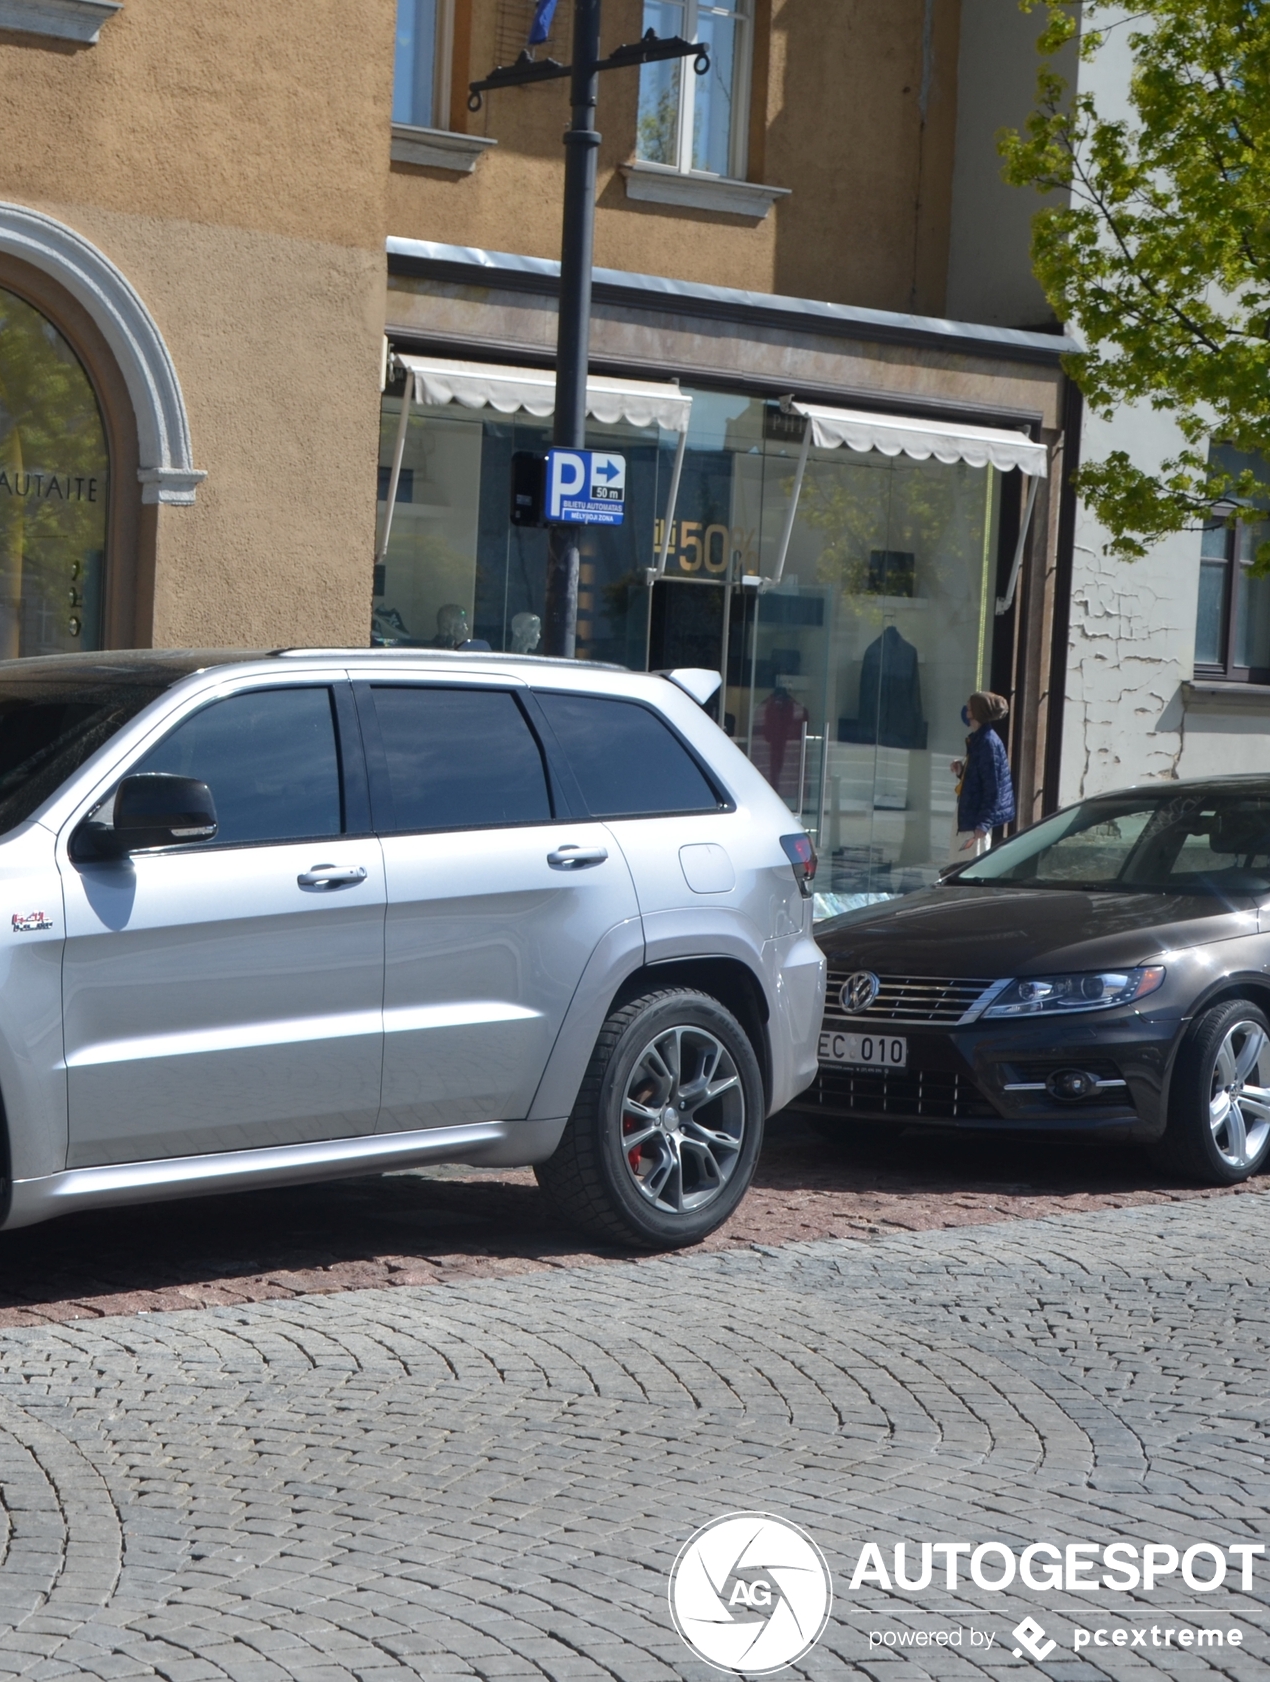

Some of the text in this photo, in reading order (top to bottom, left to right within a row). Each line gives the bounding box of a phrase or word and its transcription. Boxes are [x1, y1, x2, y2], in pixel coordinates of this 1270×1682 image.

[551, 452, 585, 516] P
[596, 487, 618, 499] 50 m
[586, 502, 623, 512] AUTOMATAS
[598, 513, 614, 522] ZONA
[861, 1037, 903, 1063] 010
